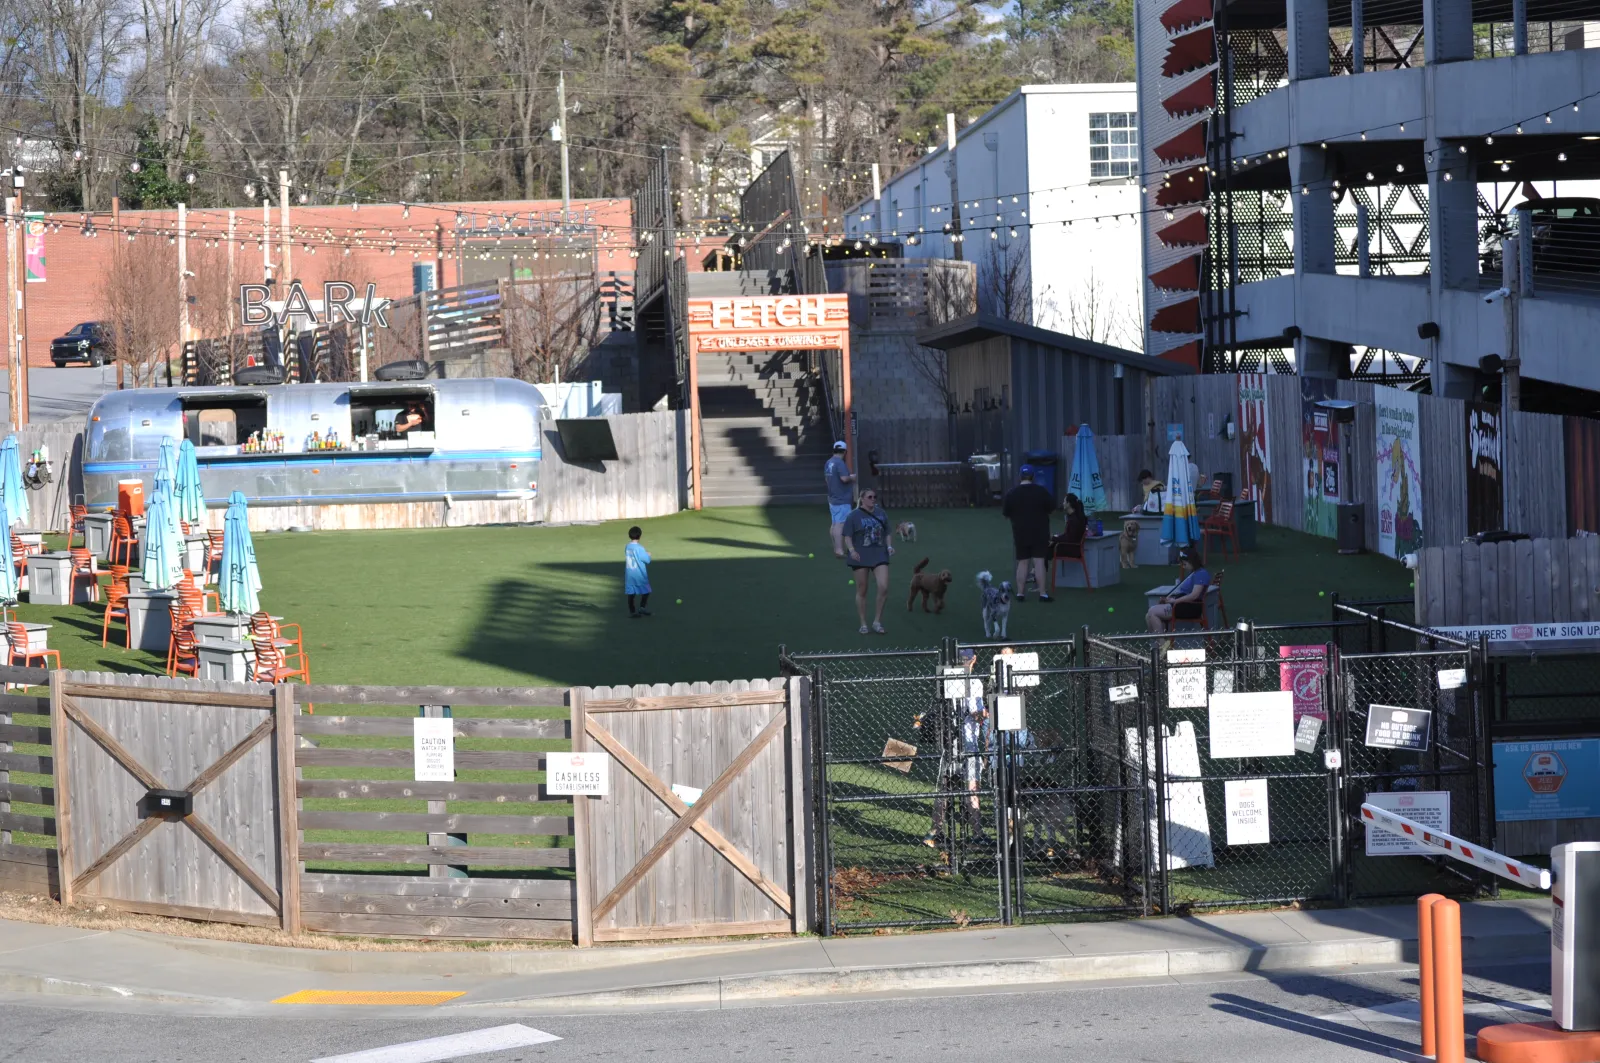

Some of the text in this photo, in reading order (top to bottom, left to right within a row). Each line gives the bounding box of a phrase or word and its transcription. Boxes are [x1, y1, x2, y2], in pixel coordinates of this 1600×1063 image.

[455, 210, 597, 233] PLAY HERE
[712, 297, 825, 329] FETCH
[717, 335, 821, 348] UNLEASH & UNWIND
[1465, 629, 1507, 641] MEMBERS
[1514, 627, 1531, 635] Fetch
[1536, 627, 1557, 638] NEW
[1560, 626, 1583, 637] SIGN
[1380, 721, 1418, 732] NO OUTSIDE
[1374, 729, 1421, 741] FOOD OR DRINK
[421, 737, 446, 745] CAUTION
[1505, 741, 1582, 753] ASK US ABOUT OUR NEW
[555, 772, 600, 782] CASHLESS
[555, 782, 600, 791] ESTABLISHMENT
[1239, 801, 1255, 809] DOGS
[1231, 808, 1263, 817] WELCOME
[1237, 816, 1257, 825] INSIDE
